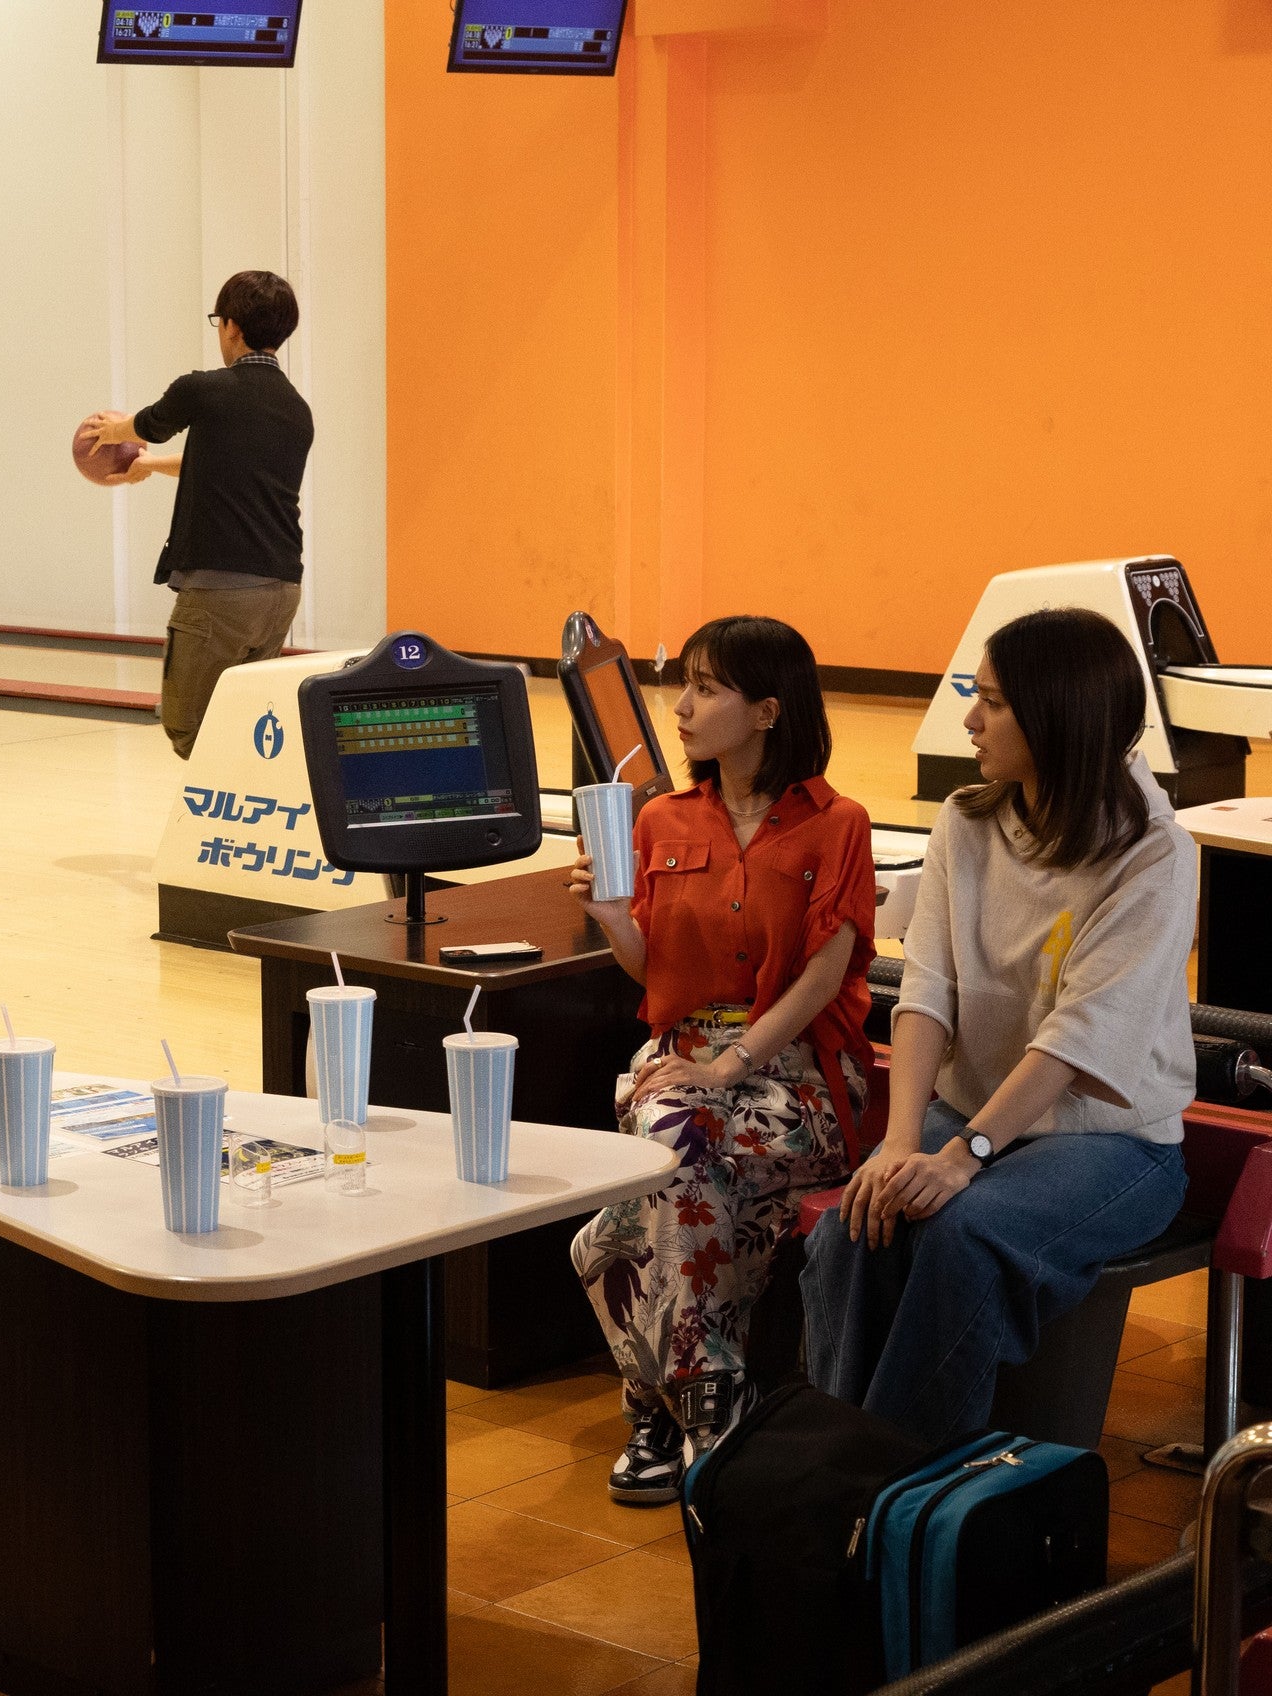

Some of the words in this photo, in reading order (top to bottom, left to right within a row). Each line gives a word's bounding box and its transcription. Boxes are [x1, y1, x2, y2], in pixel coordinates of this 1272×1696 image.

[115, 28, 132, 37] 16:21
[399, 645, 420, 660] 12
[183, 786, 311, 830] マルアイ
